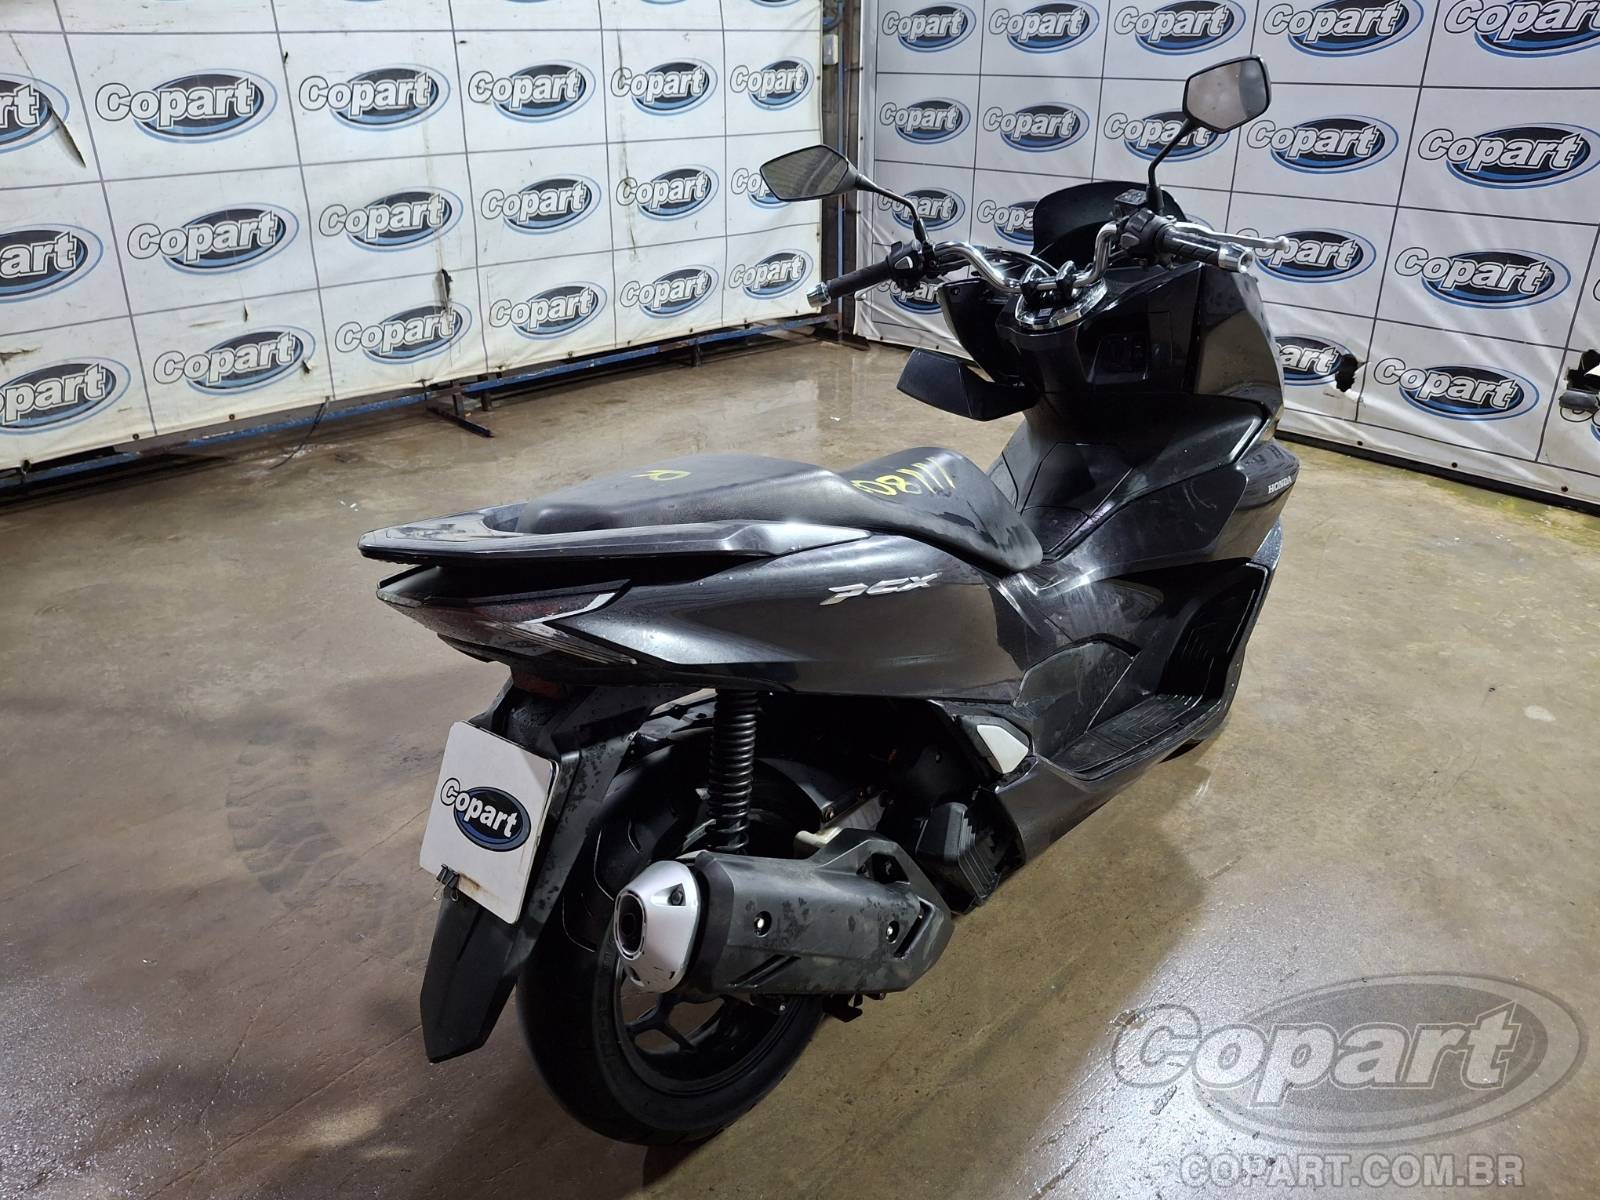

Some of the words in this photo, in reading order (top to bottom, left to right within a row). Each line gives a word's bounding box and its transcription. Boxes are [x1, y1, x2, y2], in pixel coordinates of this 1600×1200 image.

[882, 8, 964, 39] Copart
[989, 6, 1086, 39] Copart
[1114, 5, 1228, 43] Copart
[1263, 0, 1400, 43] Copart
[1444, 0, 1600, 41] Copar
[299, 73, 431, 117] Copart
[468, 67, 581, 110] Copart
[611, 62, 705, 101] Copart
[730, 63, 806, 95] Copart
[95, 77, 255, 128] Copart
[879, 102, 960, 133] Copart
[983, 106, 1078, 137] Copart
[1247, 119, 1379, 158] Copart
[1418, 128, 1580, 172] Copart
[481, 180, 587, 222] Copart
[616, 171, 707, 208] Copart
[319, 192, 445, 239] Copart
[127, 210, 278, 264] Copart
[620, 272, 709, 307] Copart
[729, 255, 806, 289] Copart
[1394, 247, 1550, 293] Copart
[489, 287, 594, 329] Copart
[335, 307, 456, 353] Copart
[153, 332, 295, 384] Copart
[1374, 357, 1519, 410] Copart
[1267, 475, 1292, 495] HONDA
[440, 777, 518, 838] Copart
